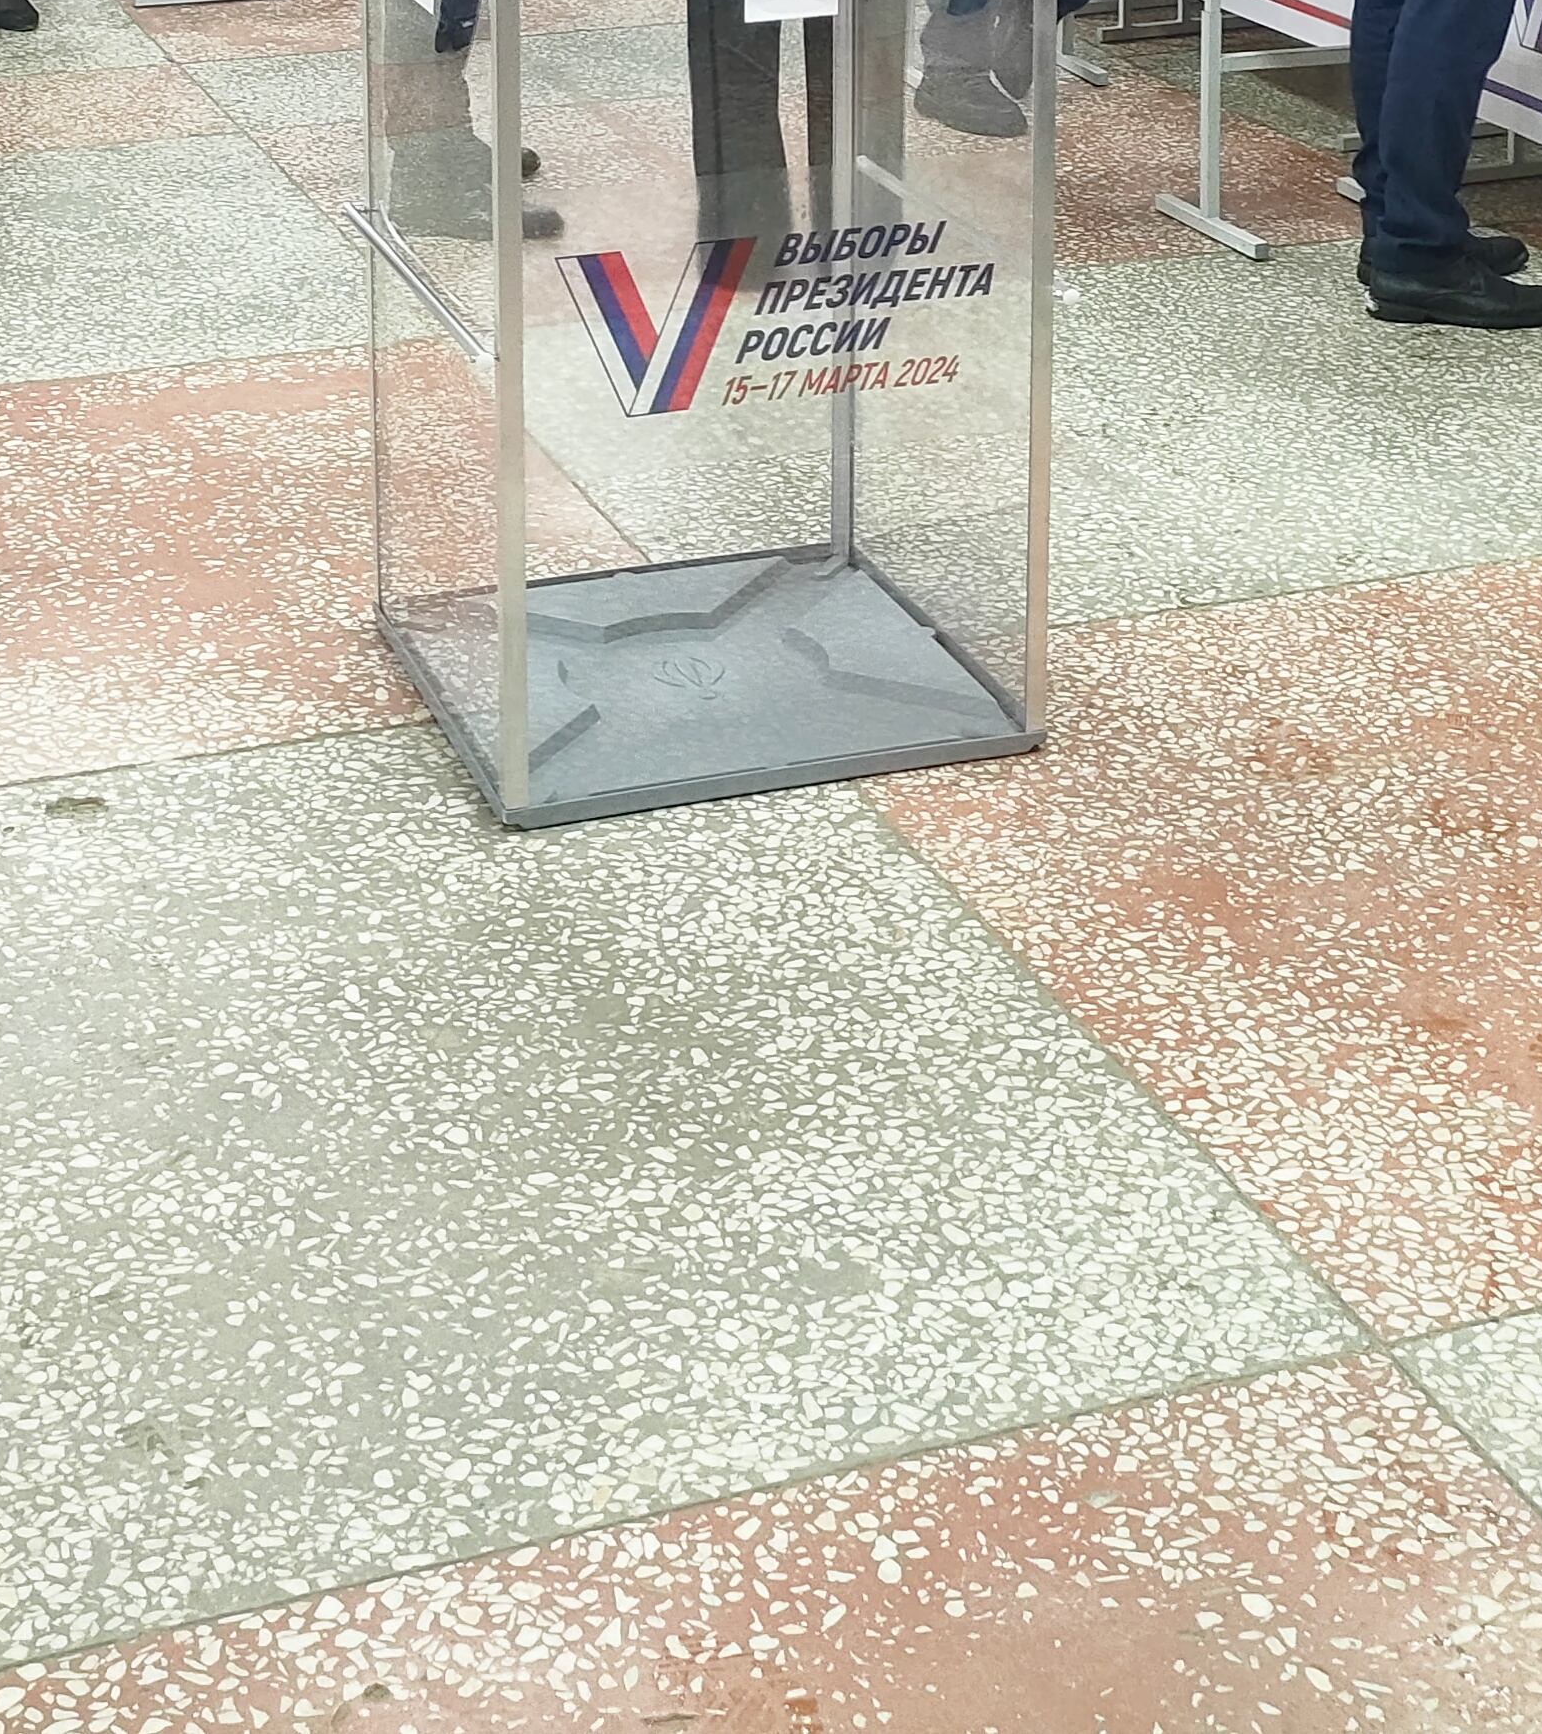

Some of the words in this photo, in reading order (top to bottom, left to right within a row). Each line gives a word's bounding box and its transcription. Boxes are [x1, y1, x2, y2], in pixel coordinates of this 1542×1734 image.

[774, 220, 947, 267] ВЫБОРЫ
[754, 263, 995, 316] ПРЕЗИДЕНТА
[735, 316, 892, 364] РОССИИ
[798, 361, 890, 397] МАРТА
[894, 355, 961, 387] 2024
